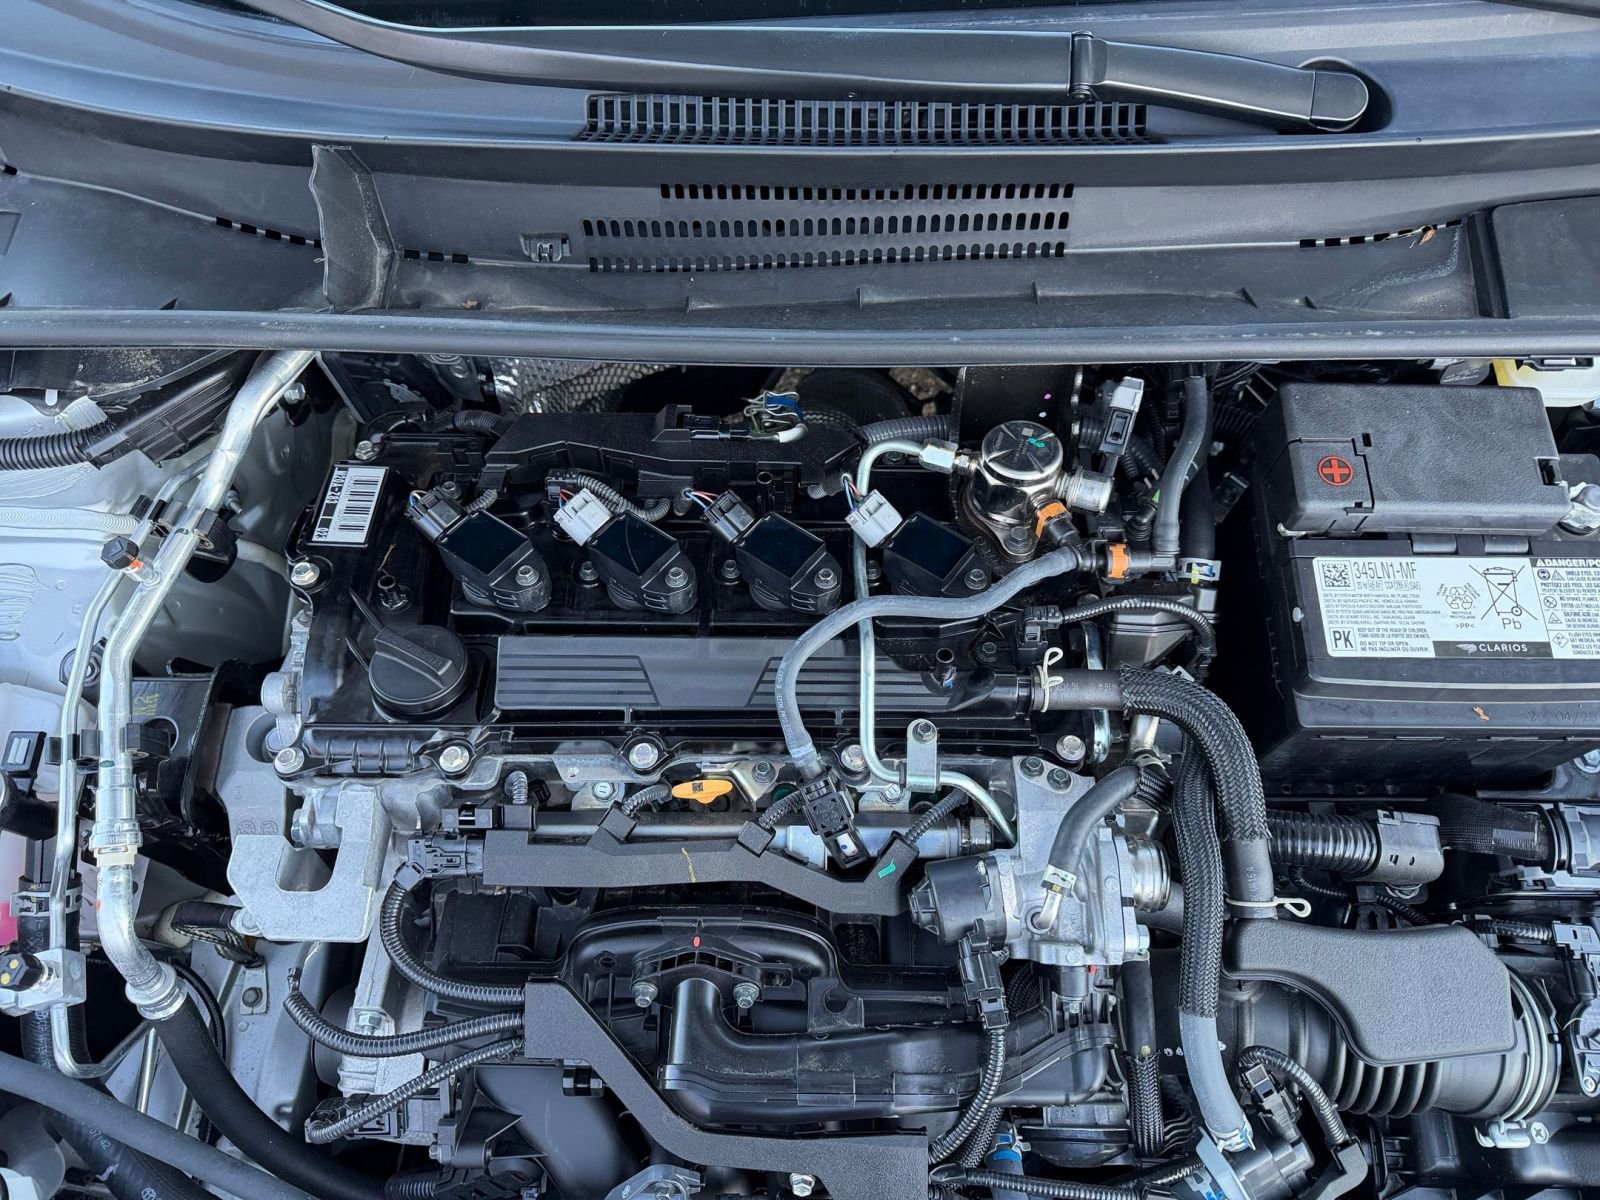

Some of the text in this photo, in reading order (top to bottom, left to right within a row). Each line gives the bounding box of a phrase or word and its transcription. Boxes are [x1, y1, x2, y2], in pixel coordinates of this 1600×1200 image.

[1353, 561, 1417, 579] 345LN1-MF
[1502, 617, 1522, 630] Pb
[1332, 630, 1354, 649] PK
[1478, 643, 1528, 652] CLARIOS
